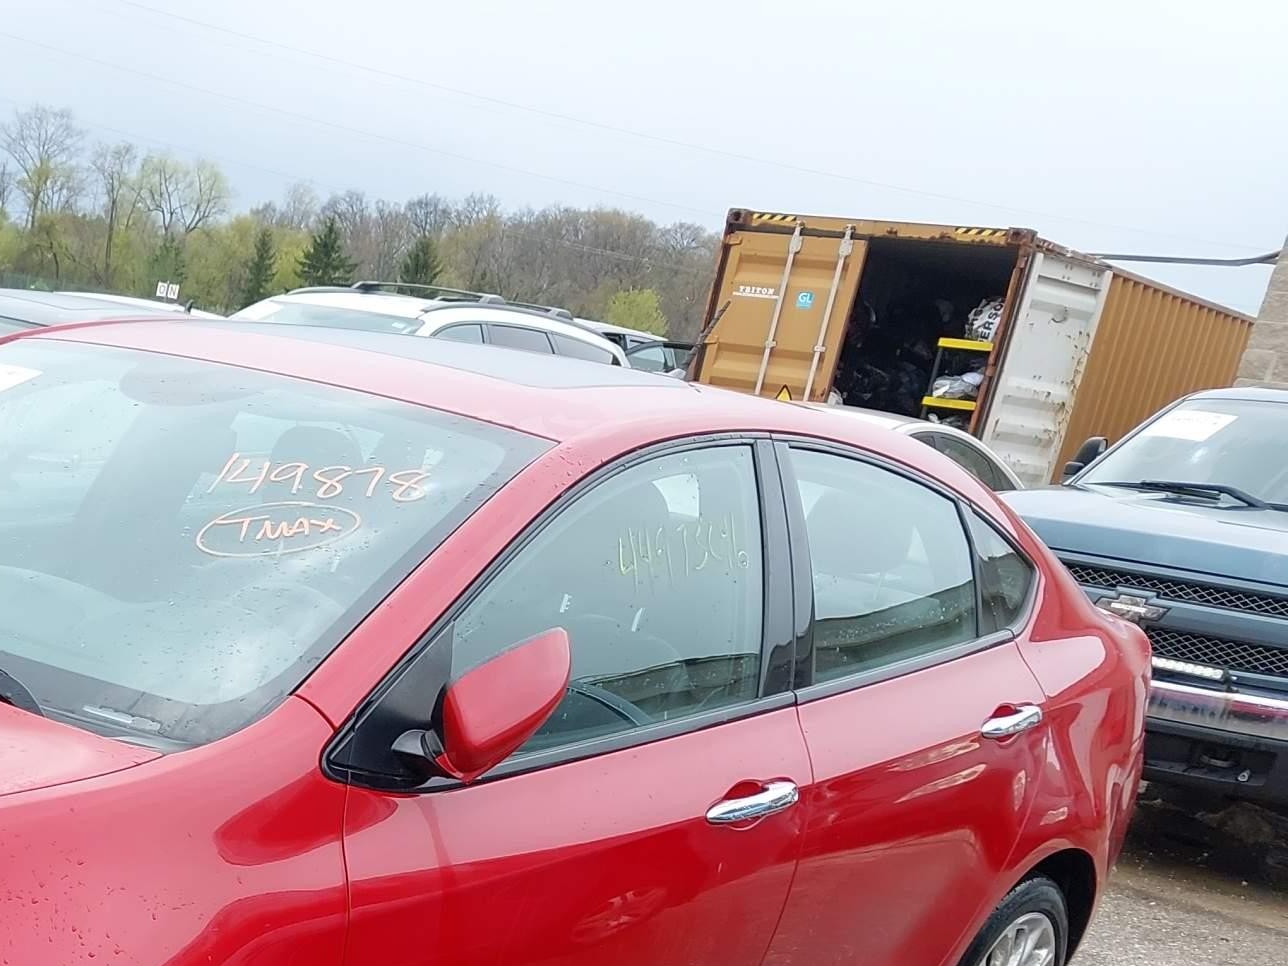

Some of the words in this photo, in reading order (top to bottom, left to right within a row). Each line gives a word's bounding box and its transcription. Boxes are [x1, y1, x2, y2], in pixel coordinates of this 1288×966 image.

[739, 285, 775, 295] TRITON
[798, 292, 812, 304] GL
[207, 452, 431, 502] 149878
